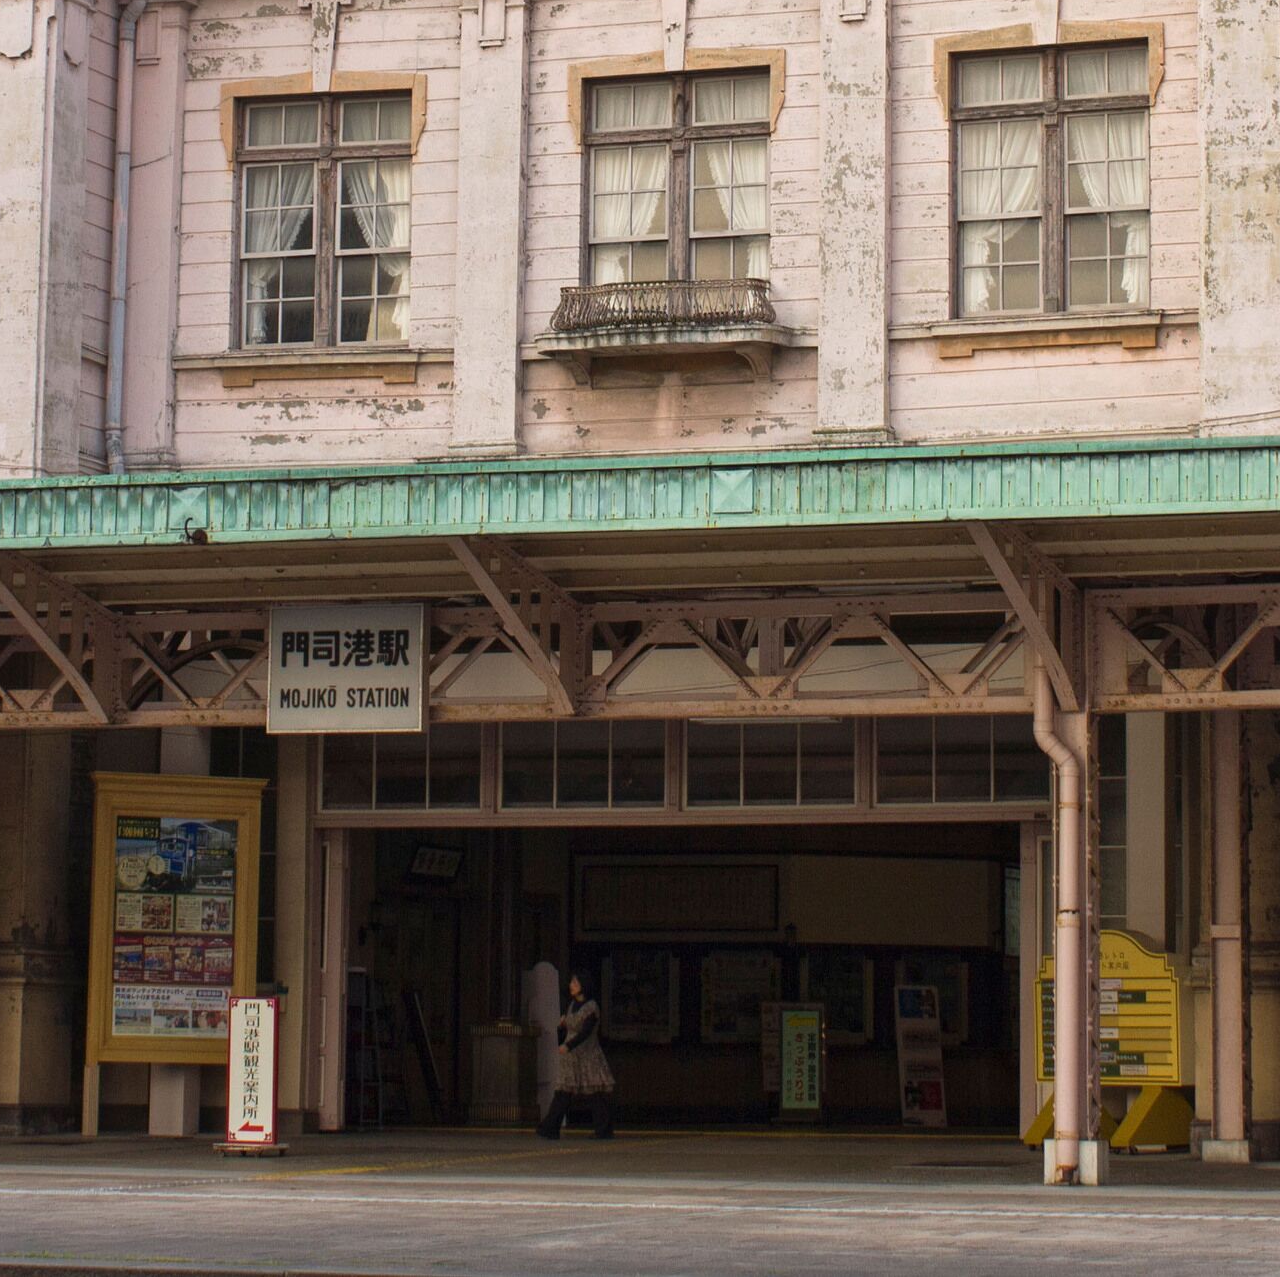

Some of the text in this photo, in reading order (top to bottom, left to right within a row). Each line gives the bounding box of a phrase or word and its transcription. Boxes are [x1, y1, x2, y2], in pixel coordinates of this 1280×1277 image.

[281, 629, 410, 668] 門司港駅
[280, 685, 410, 708] MOJIKŌ STATION
[243, 1002, 260, 1119] 門司港駅観光案内所
[794, 1032, 804, 1101] きっぷうりば
